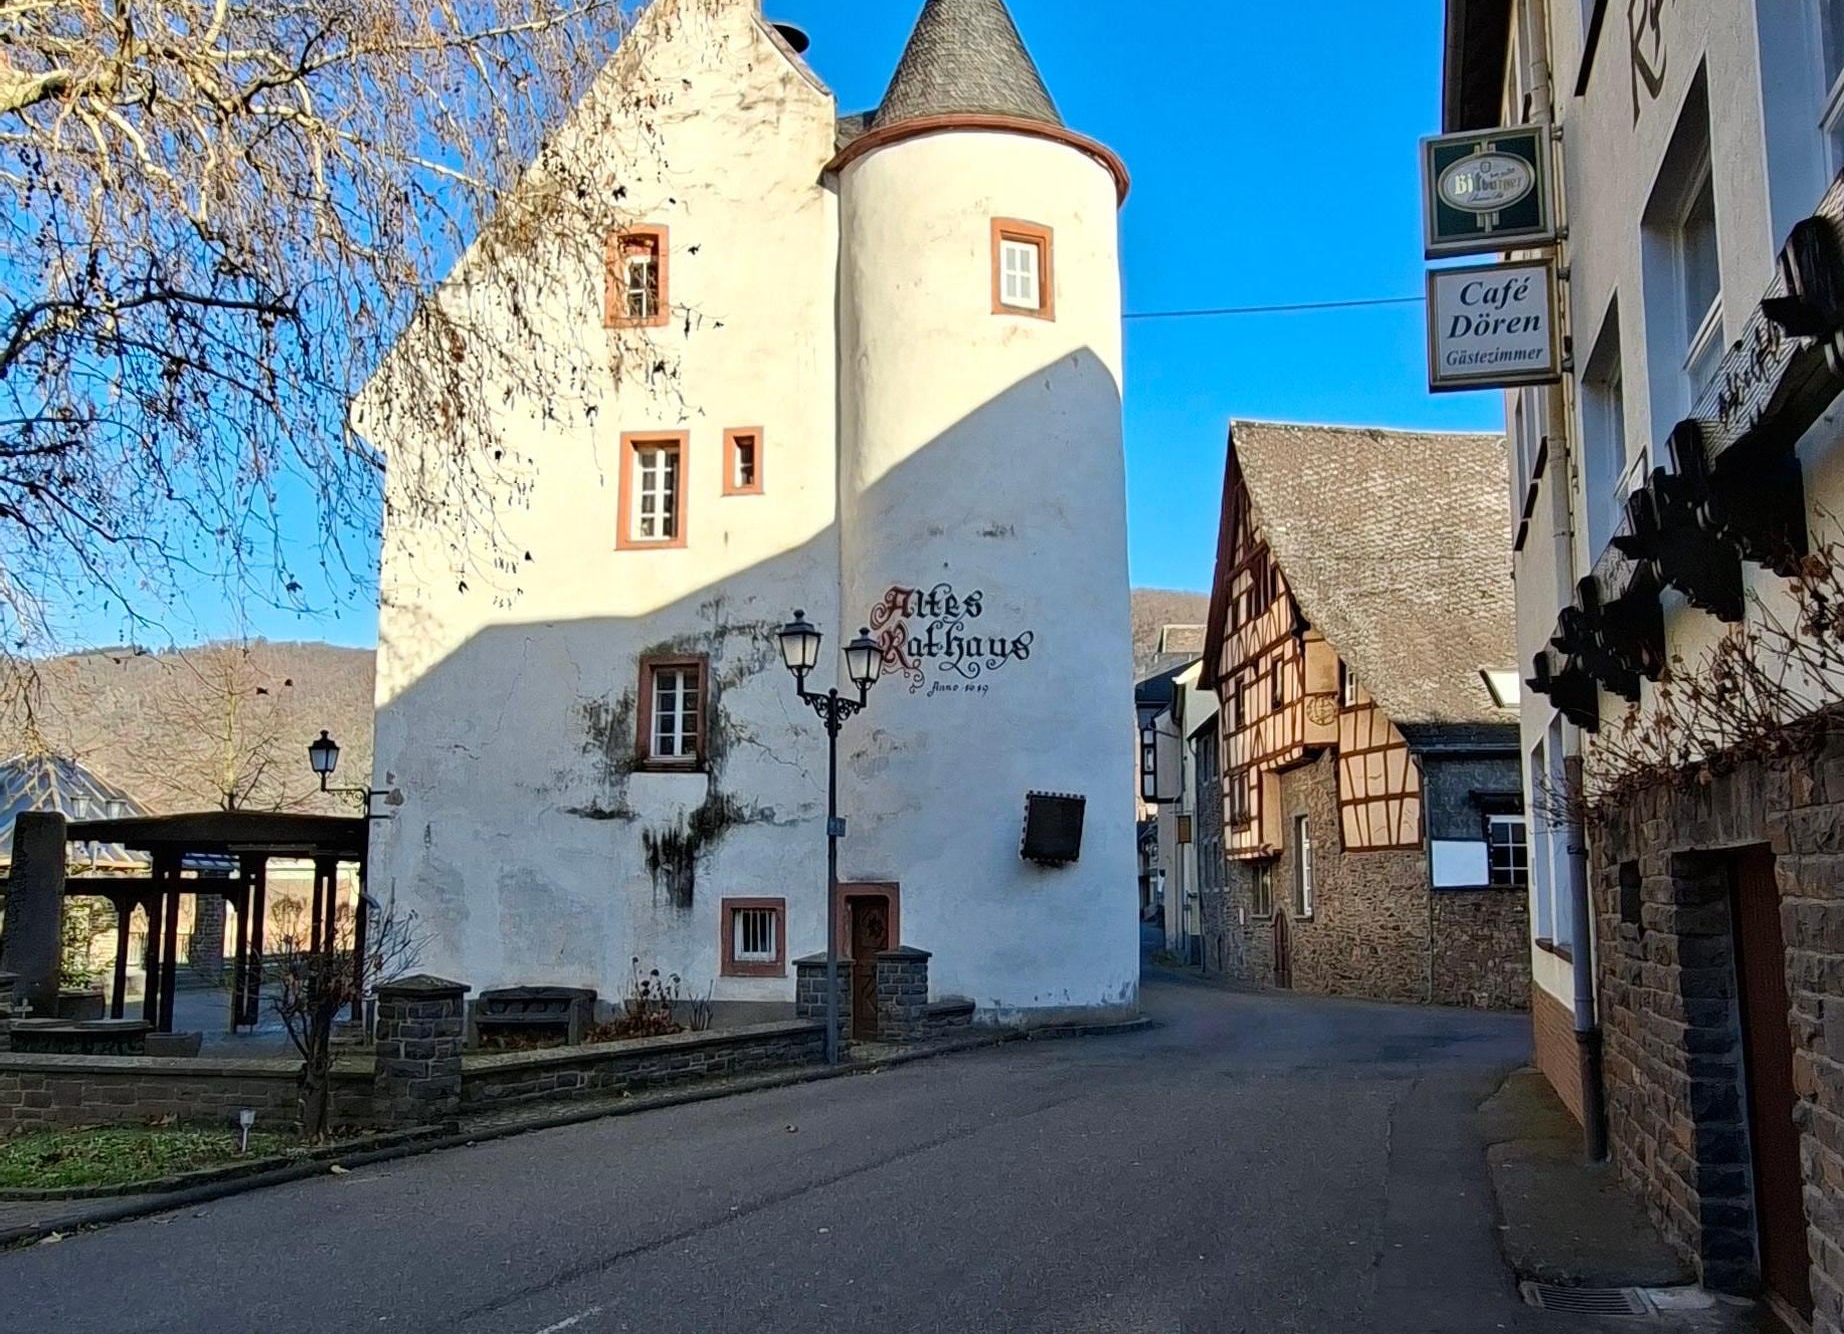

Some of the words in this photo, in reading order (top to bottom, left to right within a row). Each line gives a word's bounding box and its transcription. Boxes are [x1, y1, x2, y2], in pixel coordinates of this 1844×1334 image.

[1460, 277, 1530, 310] Café
[1447, 313, 1542, 339] Dören
[1446, 347, 1543, 366] Gästezimmer
[870, 583, 983, 630] Altes
[881, 620, 1034, 691] Rathaus
[927, 681, 959, 697] Anno
